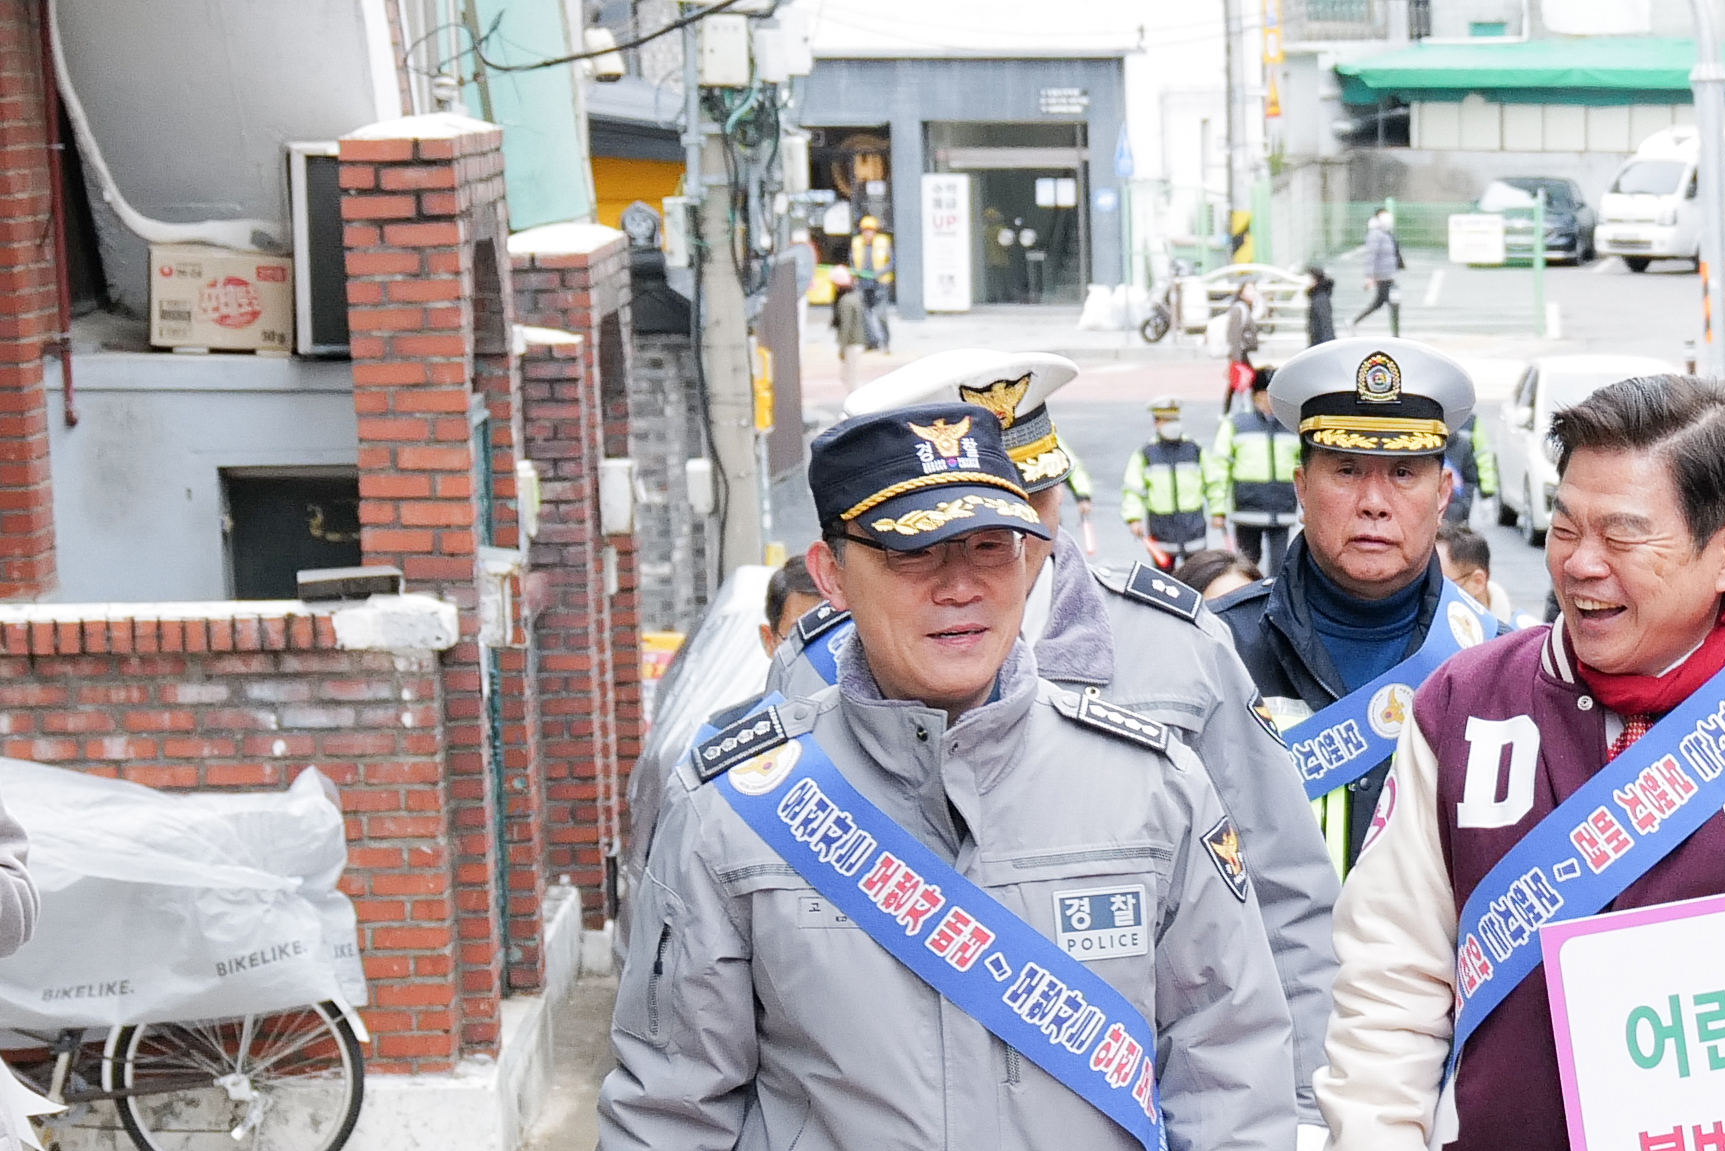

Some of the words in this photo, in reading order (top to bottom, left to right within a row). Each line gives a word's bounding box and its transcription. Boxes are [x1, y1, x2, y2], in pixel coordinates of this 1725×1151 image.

[1287, 720, 1368, 786] 보행자
[1457, 715, 1541, 829] D
[1613, 754, 1699, 835] 보행자
[777, 778, 877, 876] 운전자는
[858, 852, 947, 936] 보행자
[1003, 962, 1108, 1056] 보행자는
[1088, 1022, 1144, 1089] 안전
[1067, 933, 1139, 952] POLICE
[1478, 867, 1564, 962] 보행자는
